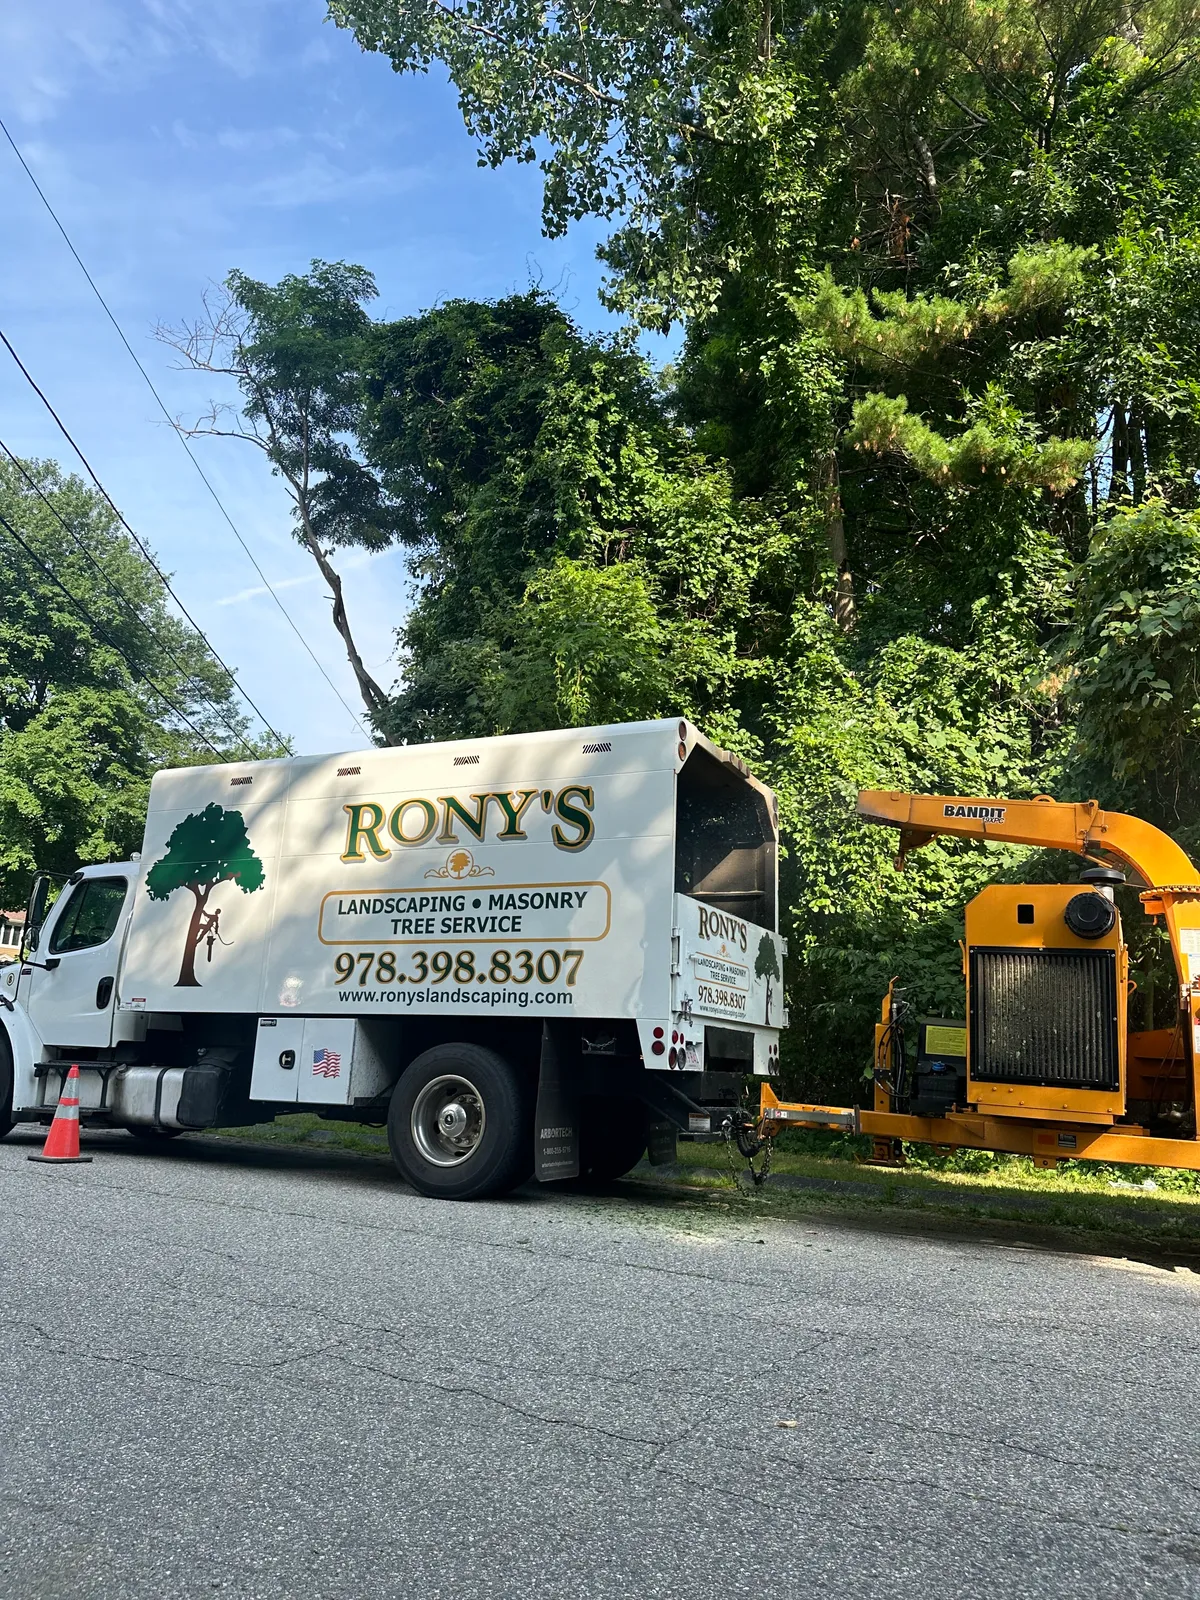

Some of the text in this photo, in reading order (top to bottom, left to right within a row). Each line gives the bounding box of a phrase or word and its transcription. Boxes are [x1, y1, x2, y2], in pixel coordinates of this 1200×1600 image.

[943, 804, 1006, 818] BANDIT
[340, 785, 595, 864] RONY'S
[338, 891, 588, 915] LANDSCAPING MASONRY
[391, 915, 522, 935] TREE SERVICE
[698, 906, 748, 954] RONY'S
[334, 949, 585, 987] 978.398.8307
[698, 958, 747, 978] LANDSCAPING MASONRY
[710, 970, 737, 985] TREE SERVICE
[338, 988, 574, 1008] www.ronyslandscaping.com
[698, 984, 747, 1011] 978.398.8307
[540, 1127, 572, 1139] ARBORTECH
